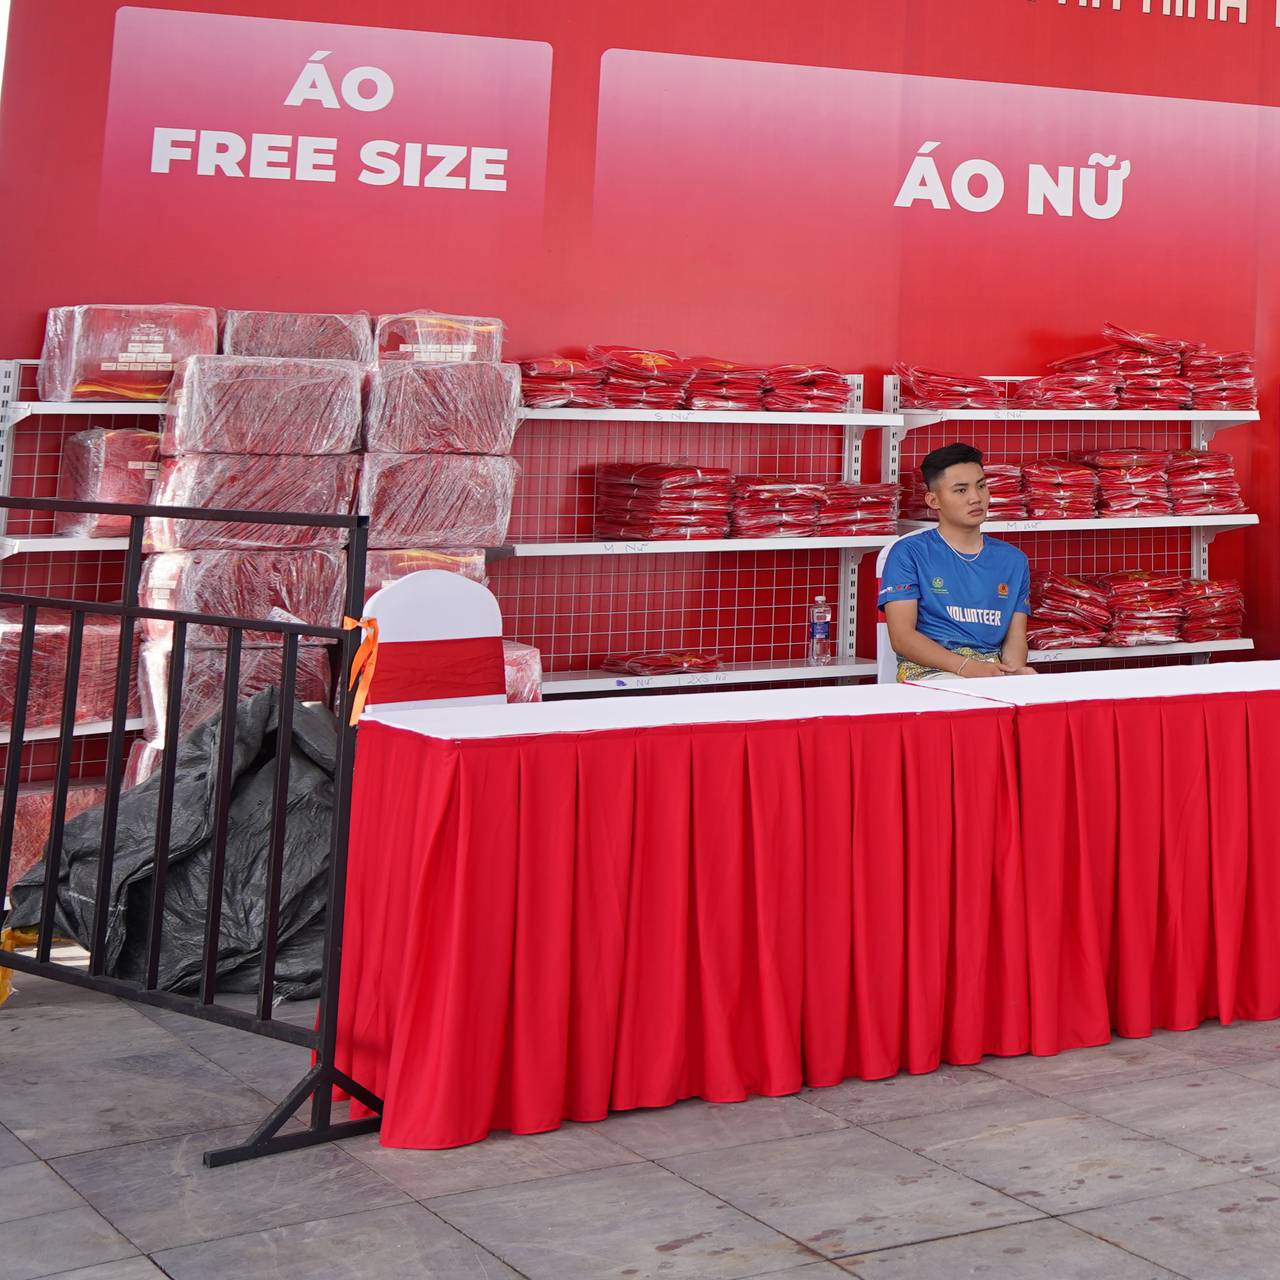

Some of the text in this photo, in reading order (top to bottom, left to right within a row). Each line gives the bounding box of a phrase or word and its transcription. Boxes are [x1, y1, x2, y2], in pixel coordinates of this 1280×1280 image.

[284, 50, 394, 112] ÁO
[150, 127, 508, 192] FREE SIZE
[894, 142, 1130, 219] ÁO NỮ
[946, 605, 1001, 626] VOLUNTEER
